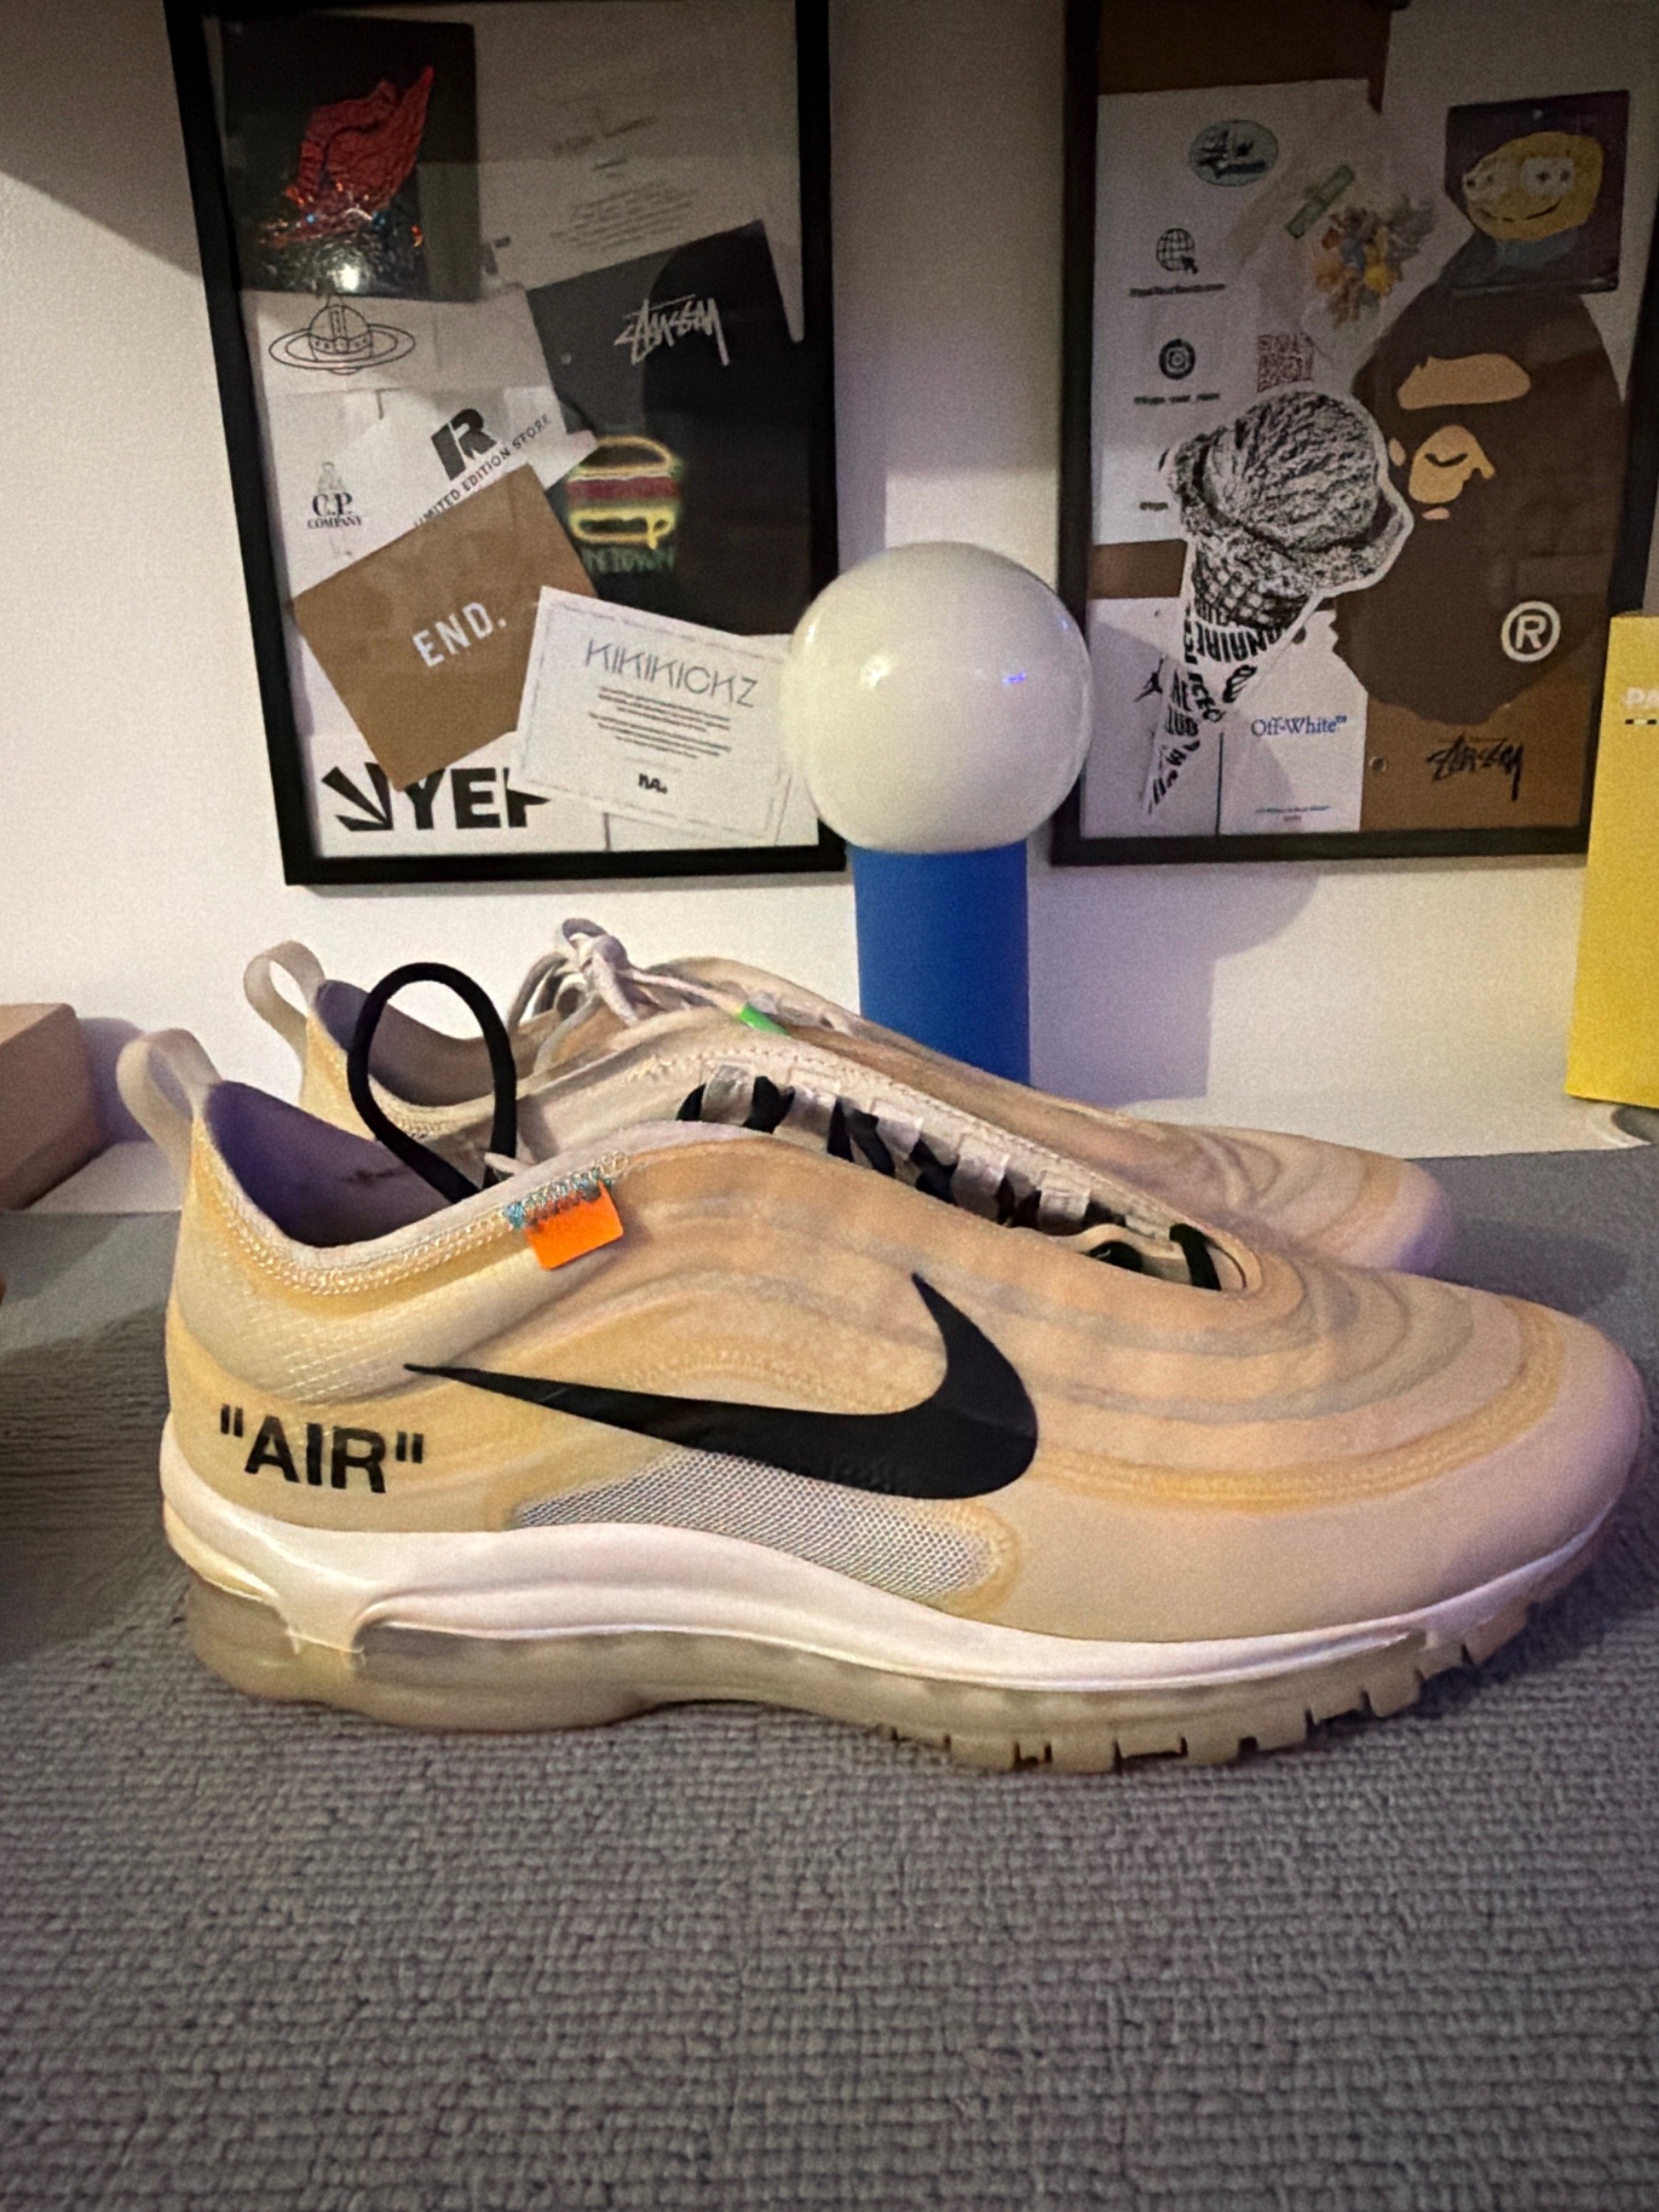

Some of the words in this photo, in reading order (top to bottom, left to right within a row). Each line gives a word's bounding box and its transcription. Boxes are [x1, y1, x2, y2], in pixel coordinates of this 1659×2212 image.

[461, 448, 511, 493] EDITION
[512, 414, 550, 450] STORE
[307, 515, 362, 529] COMPANY
[412, 602, 507, 667] END.
[585, 639, 759, 708] KIKIKICKZ
[220, 1404, 423, 1493] "AIR"
